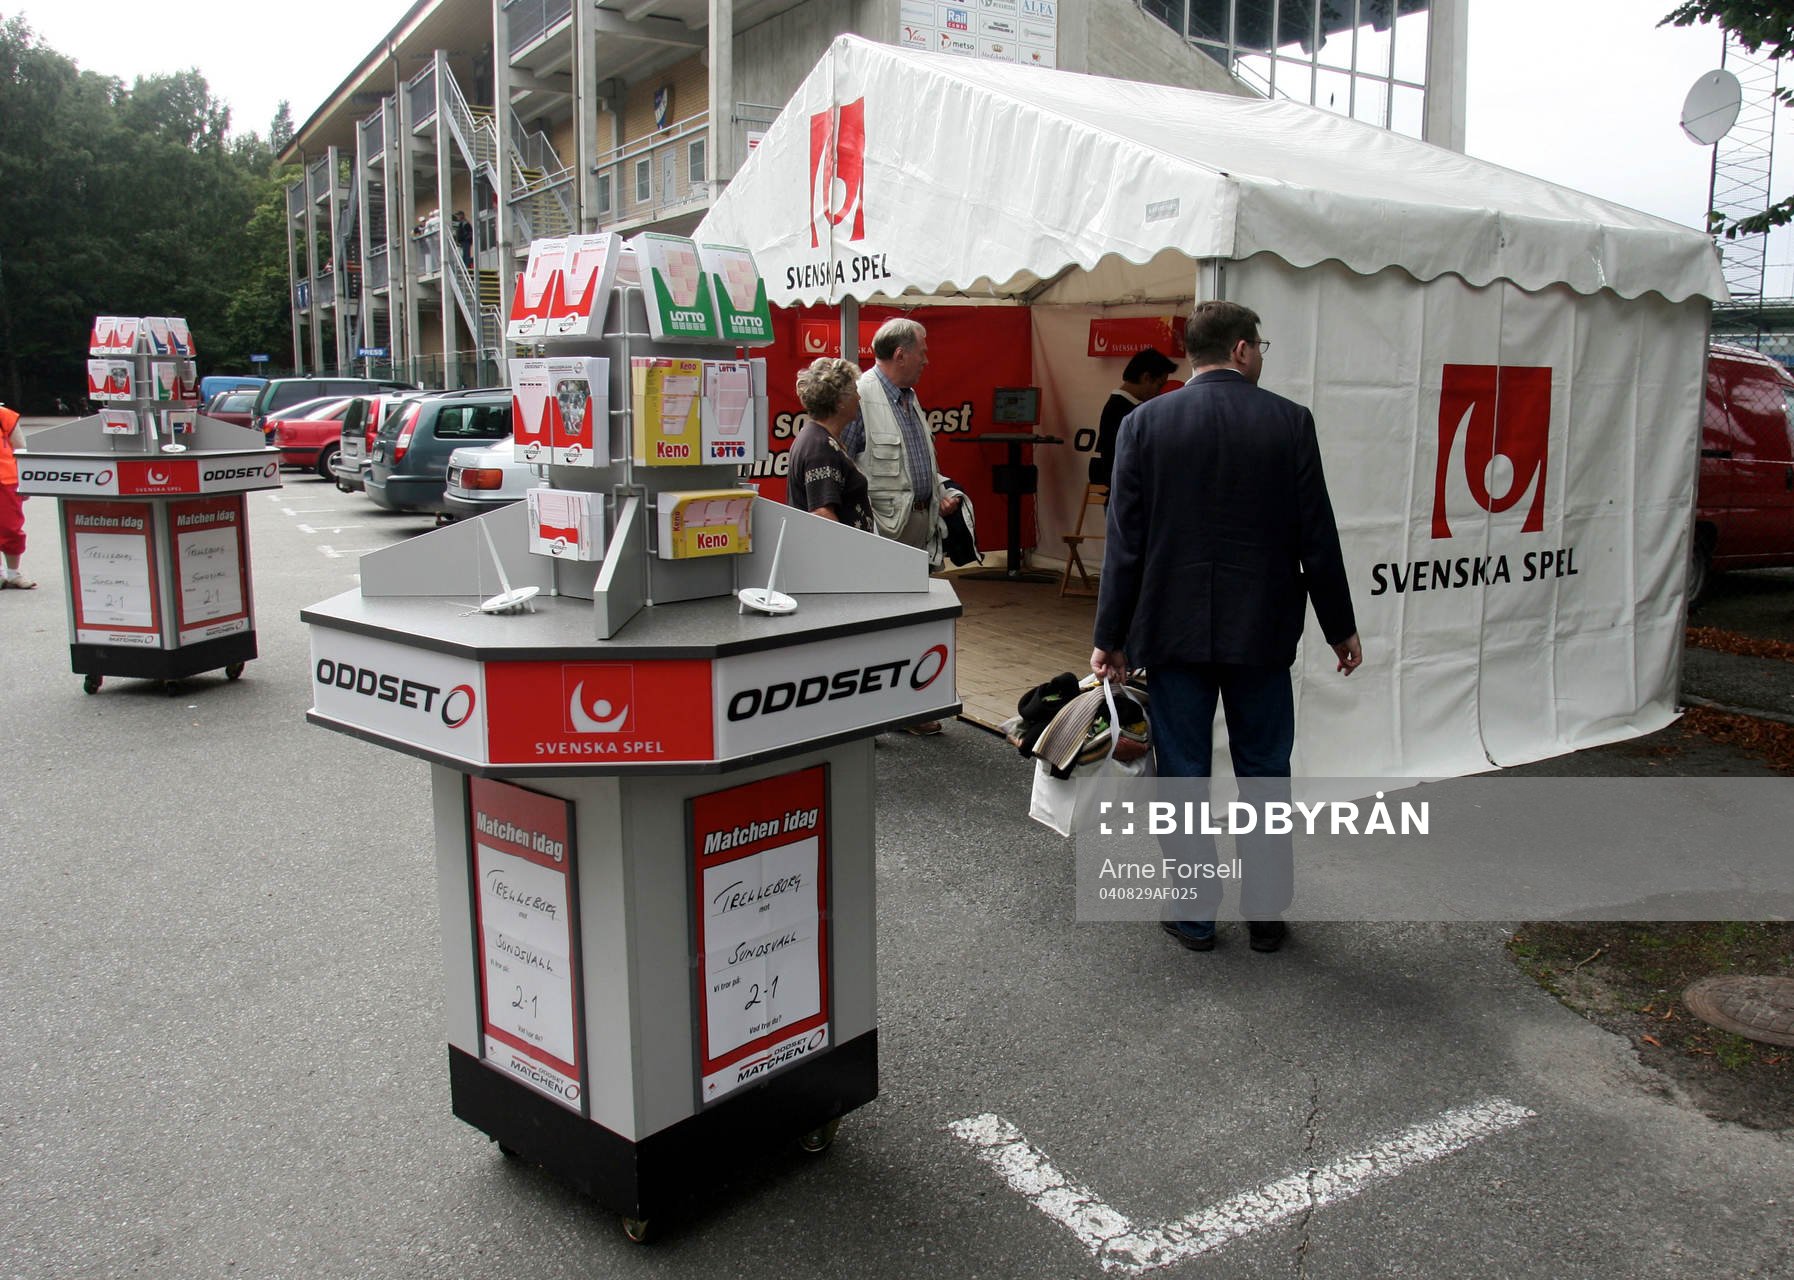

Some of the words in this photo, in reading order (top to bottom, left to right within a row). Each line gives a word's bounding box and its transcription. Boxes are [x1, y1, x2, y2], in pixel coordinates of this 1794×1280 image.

[948, 10, 966, 23] Rail
[952, 41, 975, 50] metso
[786, 259, 846, 290] SVENSKA
[851, 253, 891, 283] SPEL
[669, 310, 705, 323] LOTTO
[729, 314, 763, 327] LOTTO
[656, 441, 690, 458] Keno
[711, 446, 746, 458] LOTTO
[75, 514, 119, 527] Matchen
[121, 516, 144, 530] idag
[177, 511, 215, 526] Matchen
[216, 510, 236, 522] idag
[672, 511, 681, 532] Keno
[697, 533, 728, 549] Keno
[1371, 555, 1511, 596] SVENSKA
[1523, 547, 1578, 582] SPEL
[535, 742, 618, 755] SVENSKA
[623, 741, 665, 754] SPEL
[476, 811, 530, 848] Matchen
[532, 831, 564, 863] idag
[703, 819, 780, 855] Matchen
[783, 808, 819, 833] idag
[713, 873, 802, 913] TRELLEBORG
[759, 903, 770, 913] mot
[496, 933, 553, 972] SUNDSVALL
[727, 932, 797, 965] SUNDSVALL
[713, 985, 720, 993] Vi
[720, 980, 731, 990] tror
[744, 975, 779, 1011] 2-1
[749, 1025, 761, 1035] Vad
[761, 1020, 771, 1031] tror
[774, 1037, 808, 1055] ODDSET
[737, 1045, 806, 1083] MATCHEN
[510, 1060, 563, 1094] MATCHEN
